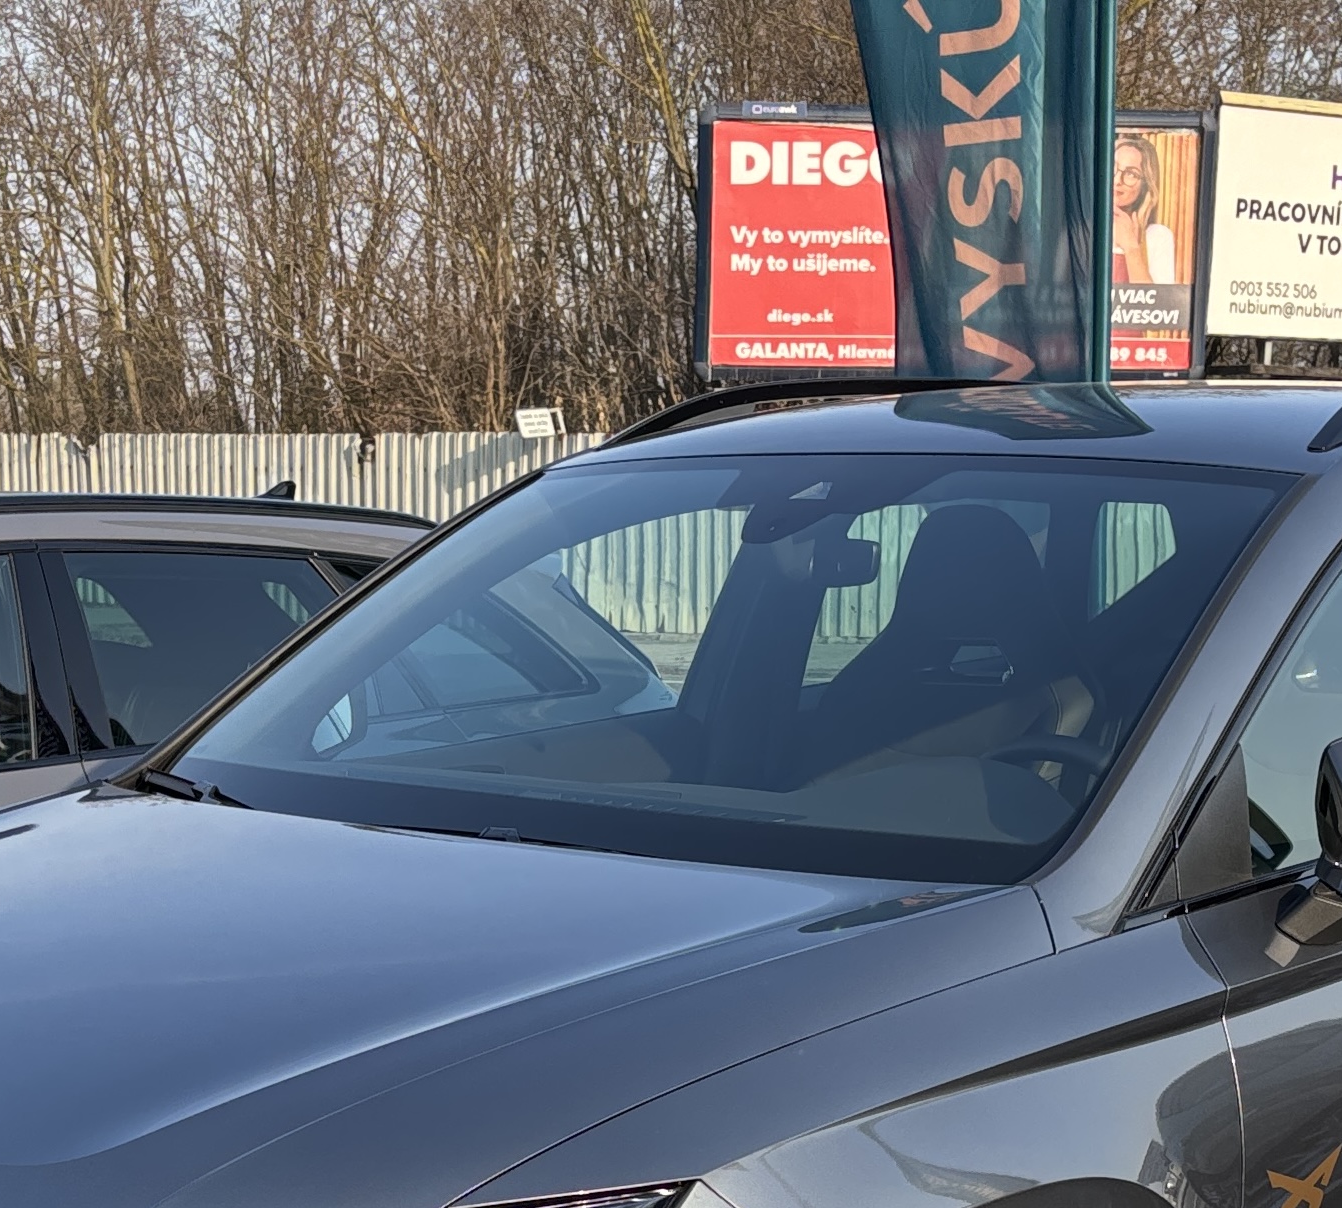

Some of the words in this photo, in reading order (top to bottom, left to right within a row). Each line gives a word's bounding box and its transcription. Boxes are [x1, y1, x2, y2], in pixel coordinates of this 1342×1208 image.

[730, 226, 758, 247] Vy
[762, 227, 783, 244] to
[788, 226, 889, 248] vymyslíte.
[1298, 233, 1313, 254] V
[730, 254, 762, 275] My
[767, 255, 788, 272] to
[793, 253, 876, 276] ušijeme.
[1119, 289, 1156, 305] VIAC
[1230, 280, 1263, 297] 0903
[1266, 282, 1290, 298] 552
[1293, 284, 1317, 300] 506
[766, 309, 834, 326] diego.sk
[1111, 305, 1179, 324] ÁVESOV!
[735, 342, 834, 362] GALANTA,
[1134, 347, 1168, 362] 845
